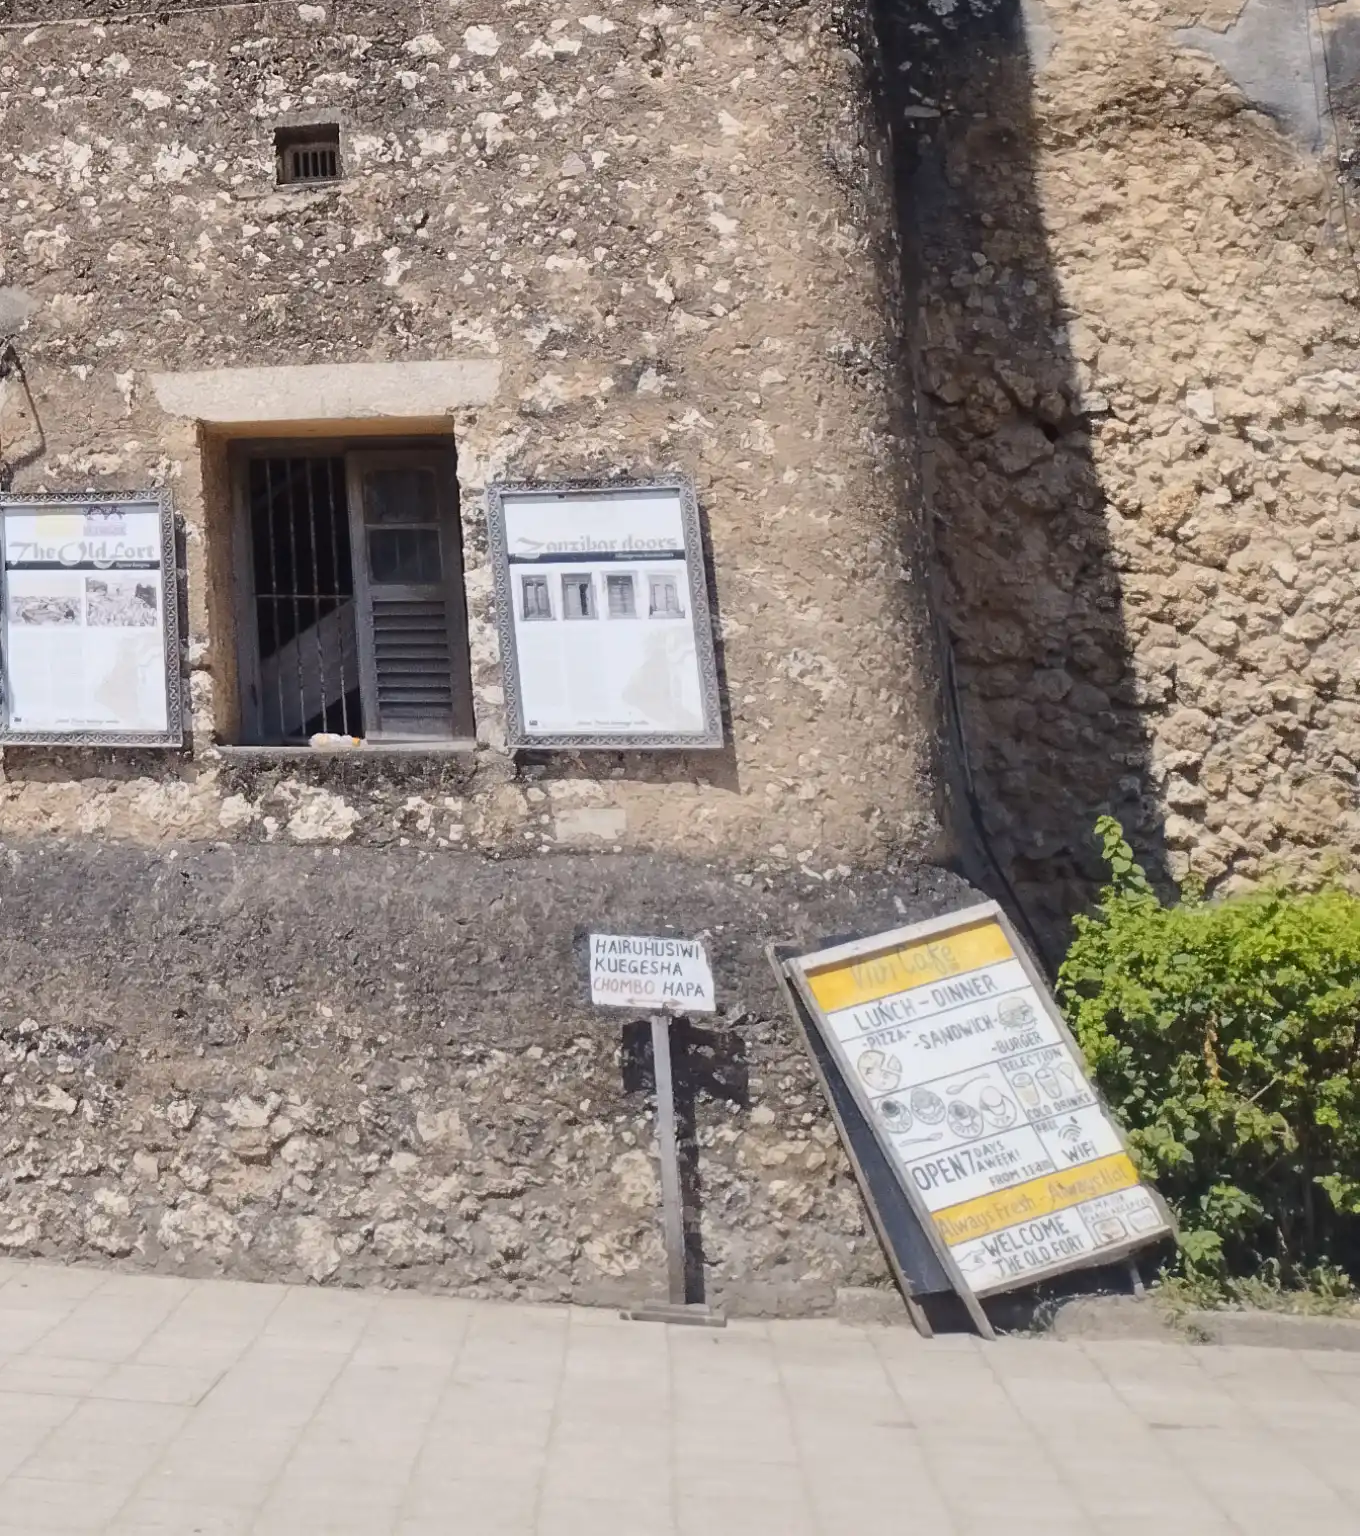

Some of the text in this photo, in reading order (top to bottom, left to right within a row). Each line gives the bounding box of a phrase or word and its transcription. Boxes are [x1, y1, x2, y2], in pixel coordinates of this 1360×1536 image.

[9, 541, 56, 566] The
[57, 541, 107, 566] Old
[622, 534, 678, 551] doors
[594, 939, 700, 960] HAIRUHUSIWI
[594, 958, 683, 976] KUEGESHA
[593, 976, 705, 998] CHOMBO HAPA
[853, 997, 915, 1031] LUNCH
[931, 974, 999, 1007] DINNER
[911, 1151, 968, 1190] OPEN
[972, 1140, 1005, 1158] DAYS
[989, 1170, 1020, 1187] FROM
[981, 1215, 1070, 1257] WELCOME
[992, 1234, 1085, 1278] THE OLD FORT
